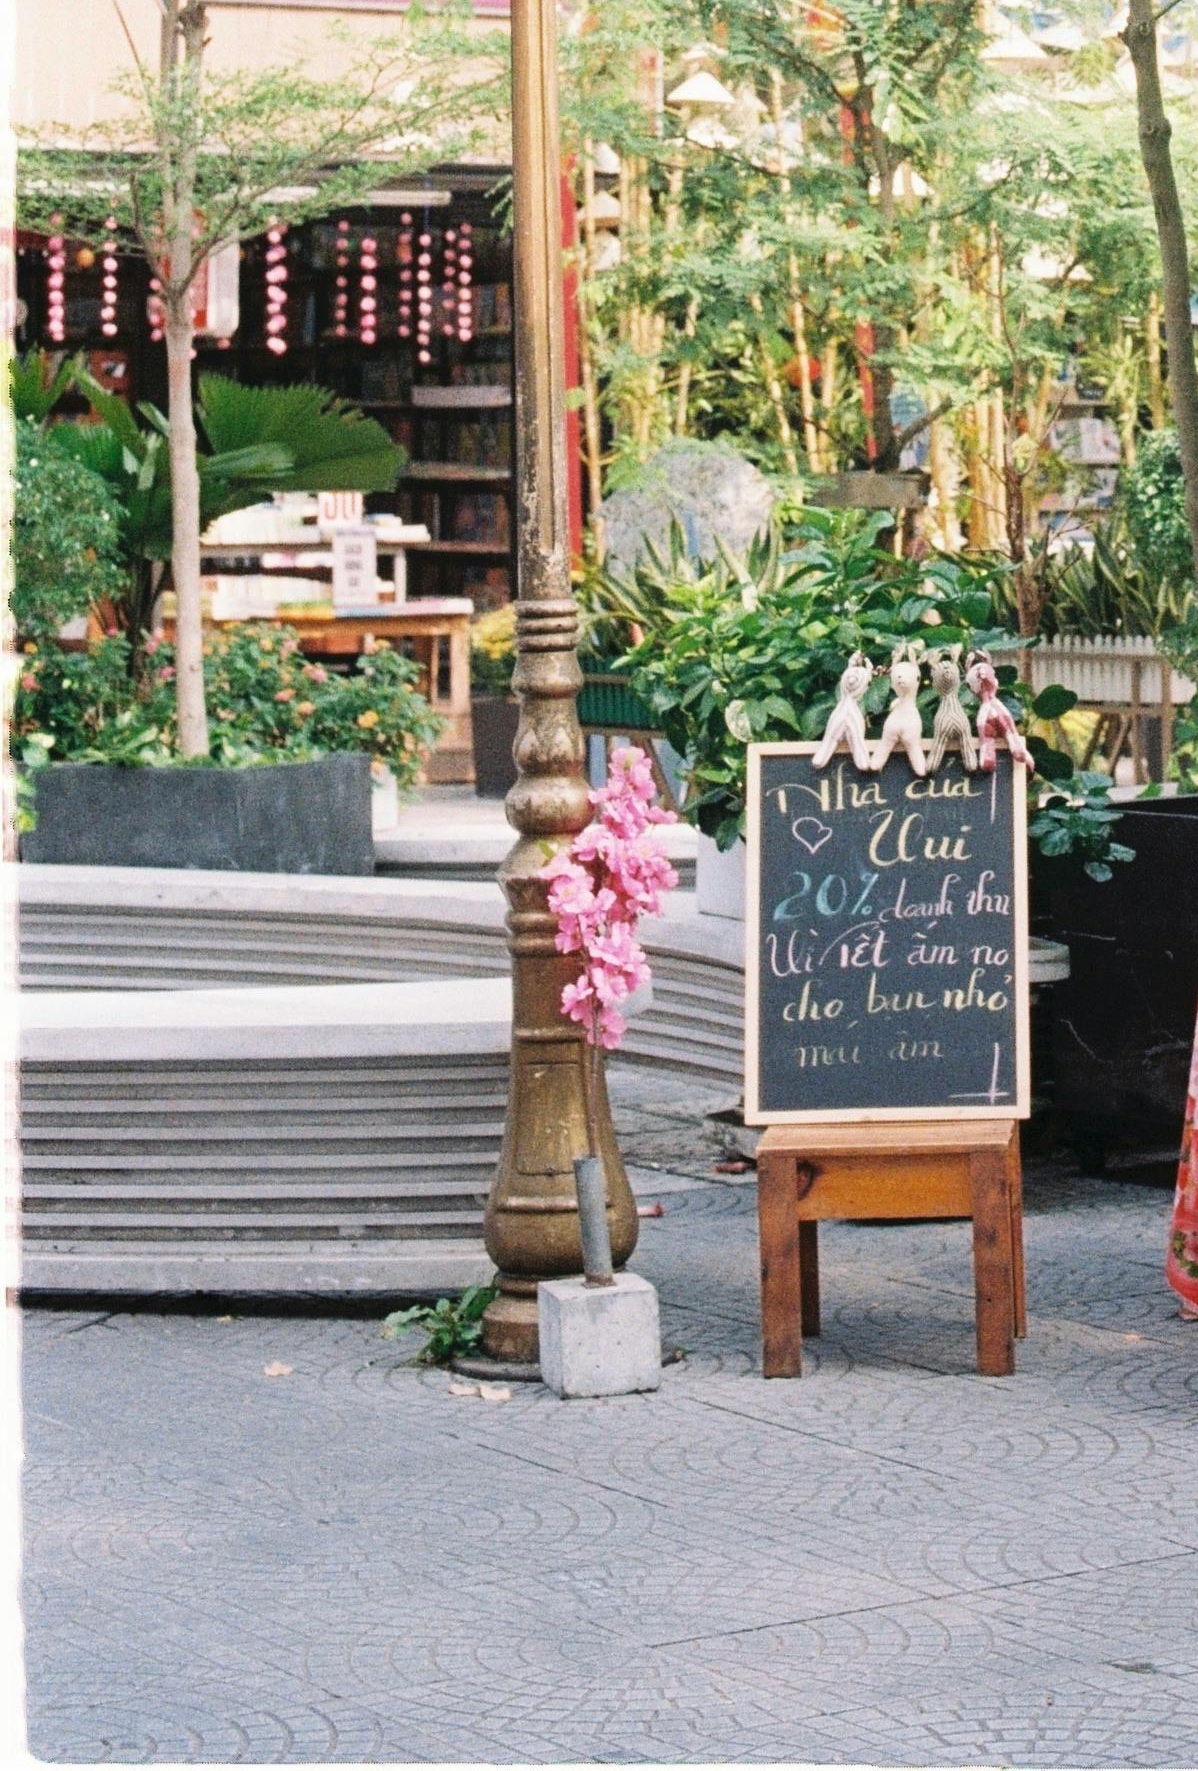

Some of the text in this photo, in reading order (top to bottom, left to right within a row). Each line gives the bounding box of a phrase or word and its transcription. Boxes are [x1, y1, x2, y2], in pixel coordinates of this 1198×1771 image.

[773, 870, 880, 921] 20%
[973, 944, 1010, 966] no
[783, 980, 844, 1022] cho
